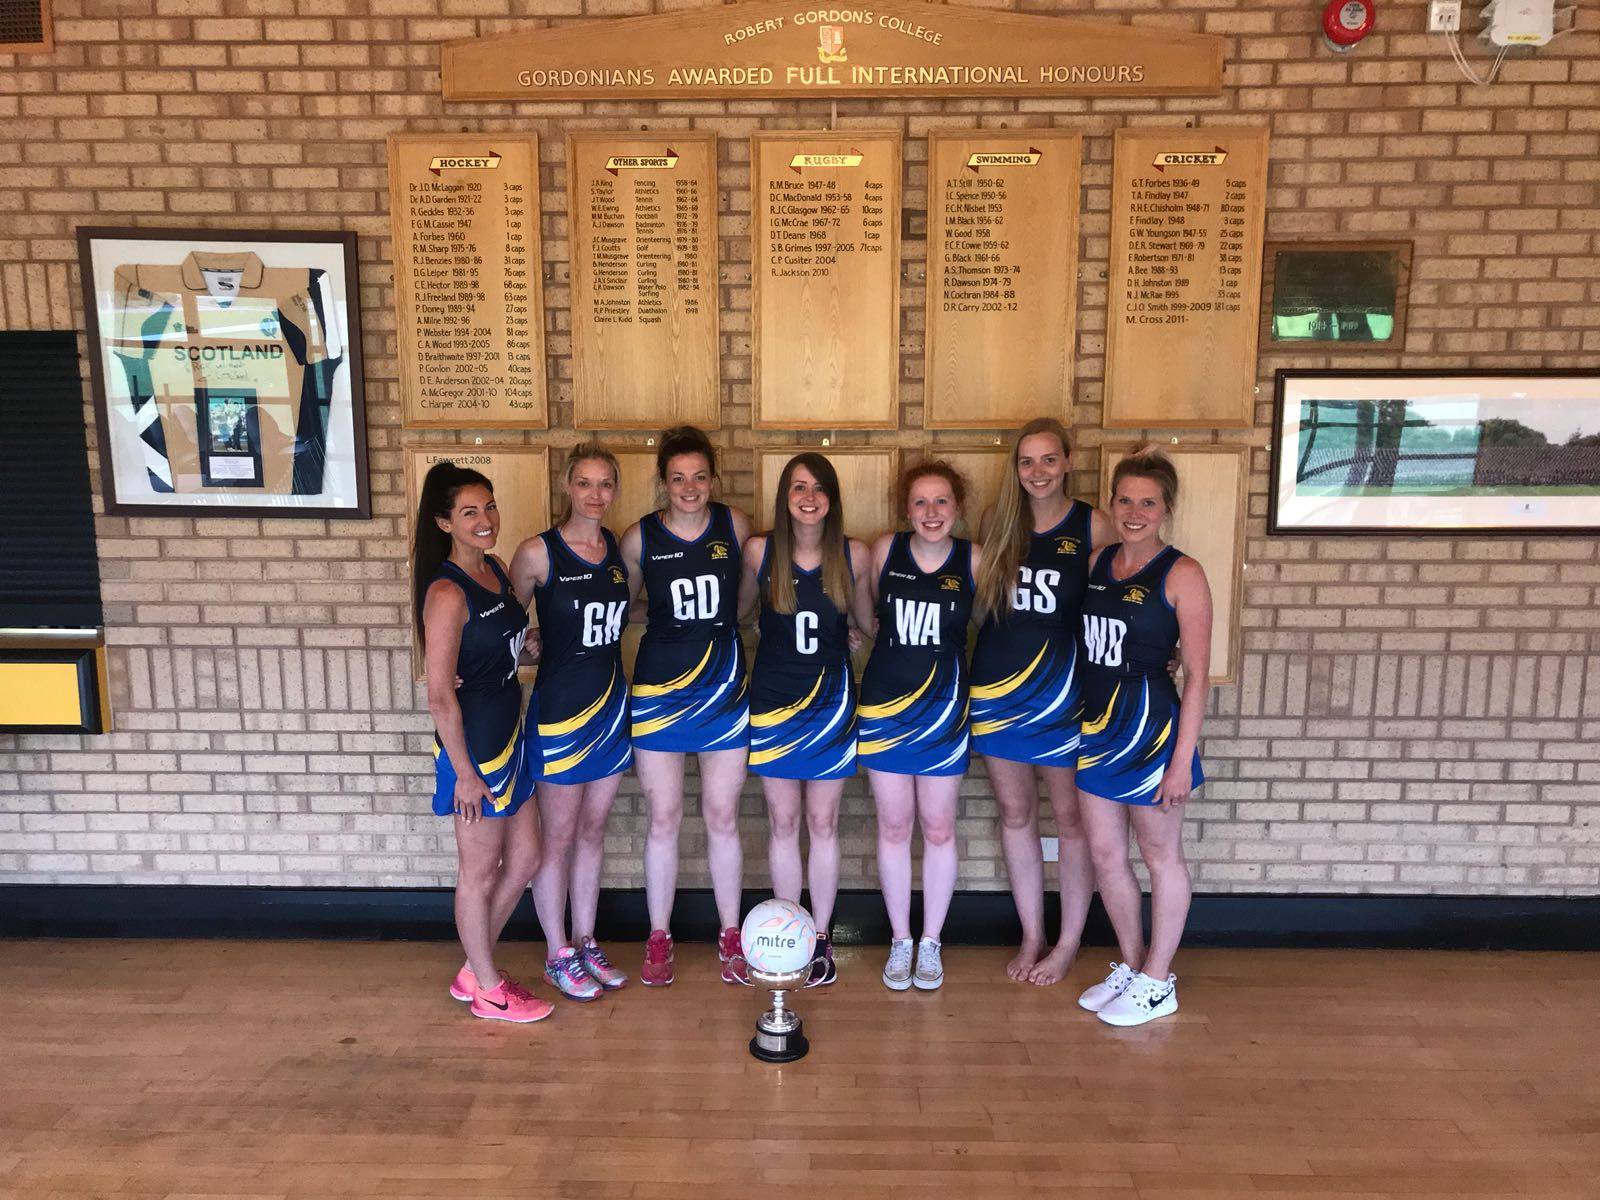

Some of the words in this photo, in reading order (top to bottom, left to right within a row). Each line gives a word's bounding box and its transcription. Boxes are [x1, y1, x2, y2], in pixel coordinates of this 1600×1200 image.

[724, 17, 785, 46] ROBERT
[793, 10, 874, 26] GORDON'S
[878, 15, 944, 46] COLLEGE
[517, 69, 656, 87] GORDONIANS
[667, 67, 774, 86] AWARDED
[785, 66, 842, 86] FULL
[851, 66, 1029, 85] INTERNATIONAL
[1039, 65, 1145, 83] HONOURS
[440, 159, 490, 168] HOCKEY
[640, 158, 668, 166] SPORTS
[804, 157, 847, 165] RUGBY
[1164, 155, 1217, 164] CRICKET
[1173, 191, 1188, 199] 1947
[988, 204, 1002, 212] 1953
[457, 220, 472, 228] 1947
[1168, 216, 1185, 224] 1948
[448, 233, 466, 241] 1960
[809, 231, 826, 239] 1968
[976, 229, 990, 237] 1958
[815, 256, 836, 264] 2004
[1139, 316, 1163, 324] Cross
[174, 344, 282, 360] SCOTLAND
[1012, 566, 1061, 614] GS
[670, 575, 720, 620] GD
[582, 600, 628, 647] GK
[896, 598, 941, 646] WA
[796, 611, 818, 654] C
[756, 936, 796, 948] mitre
